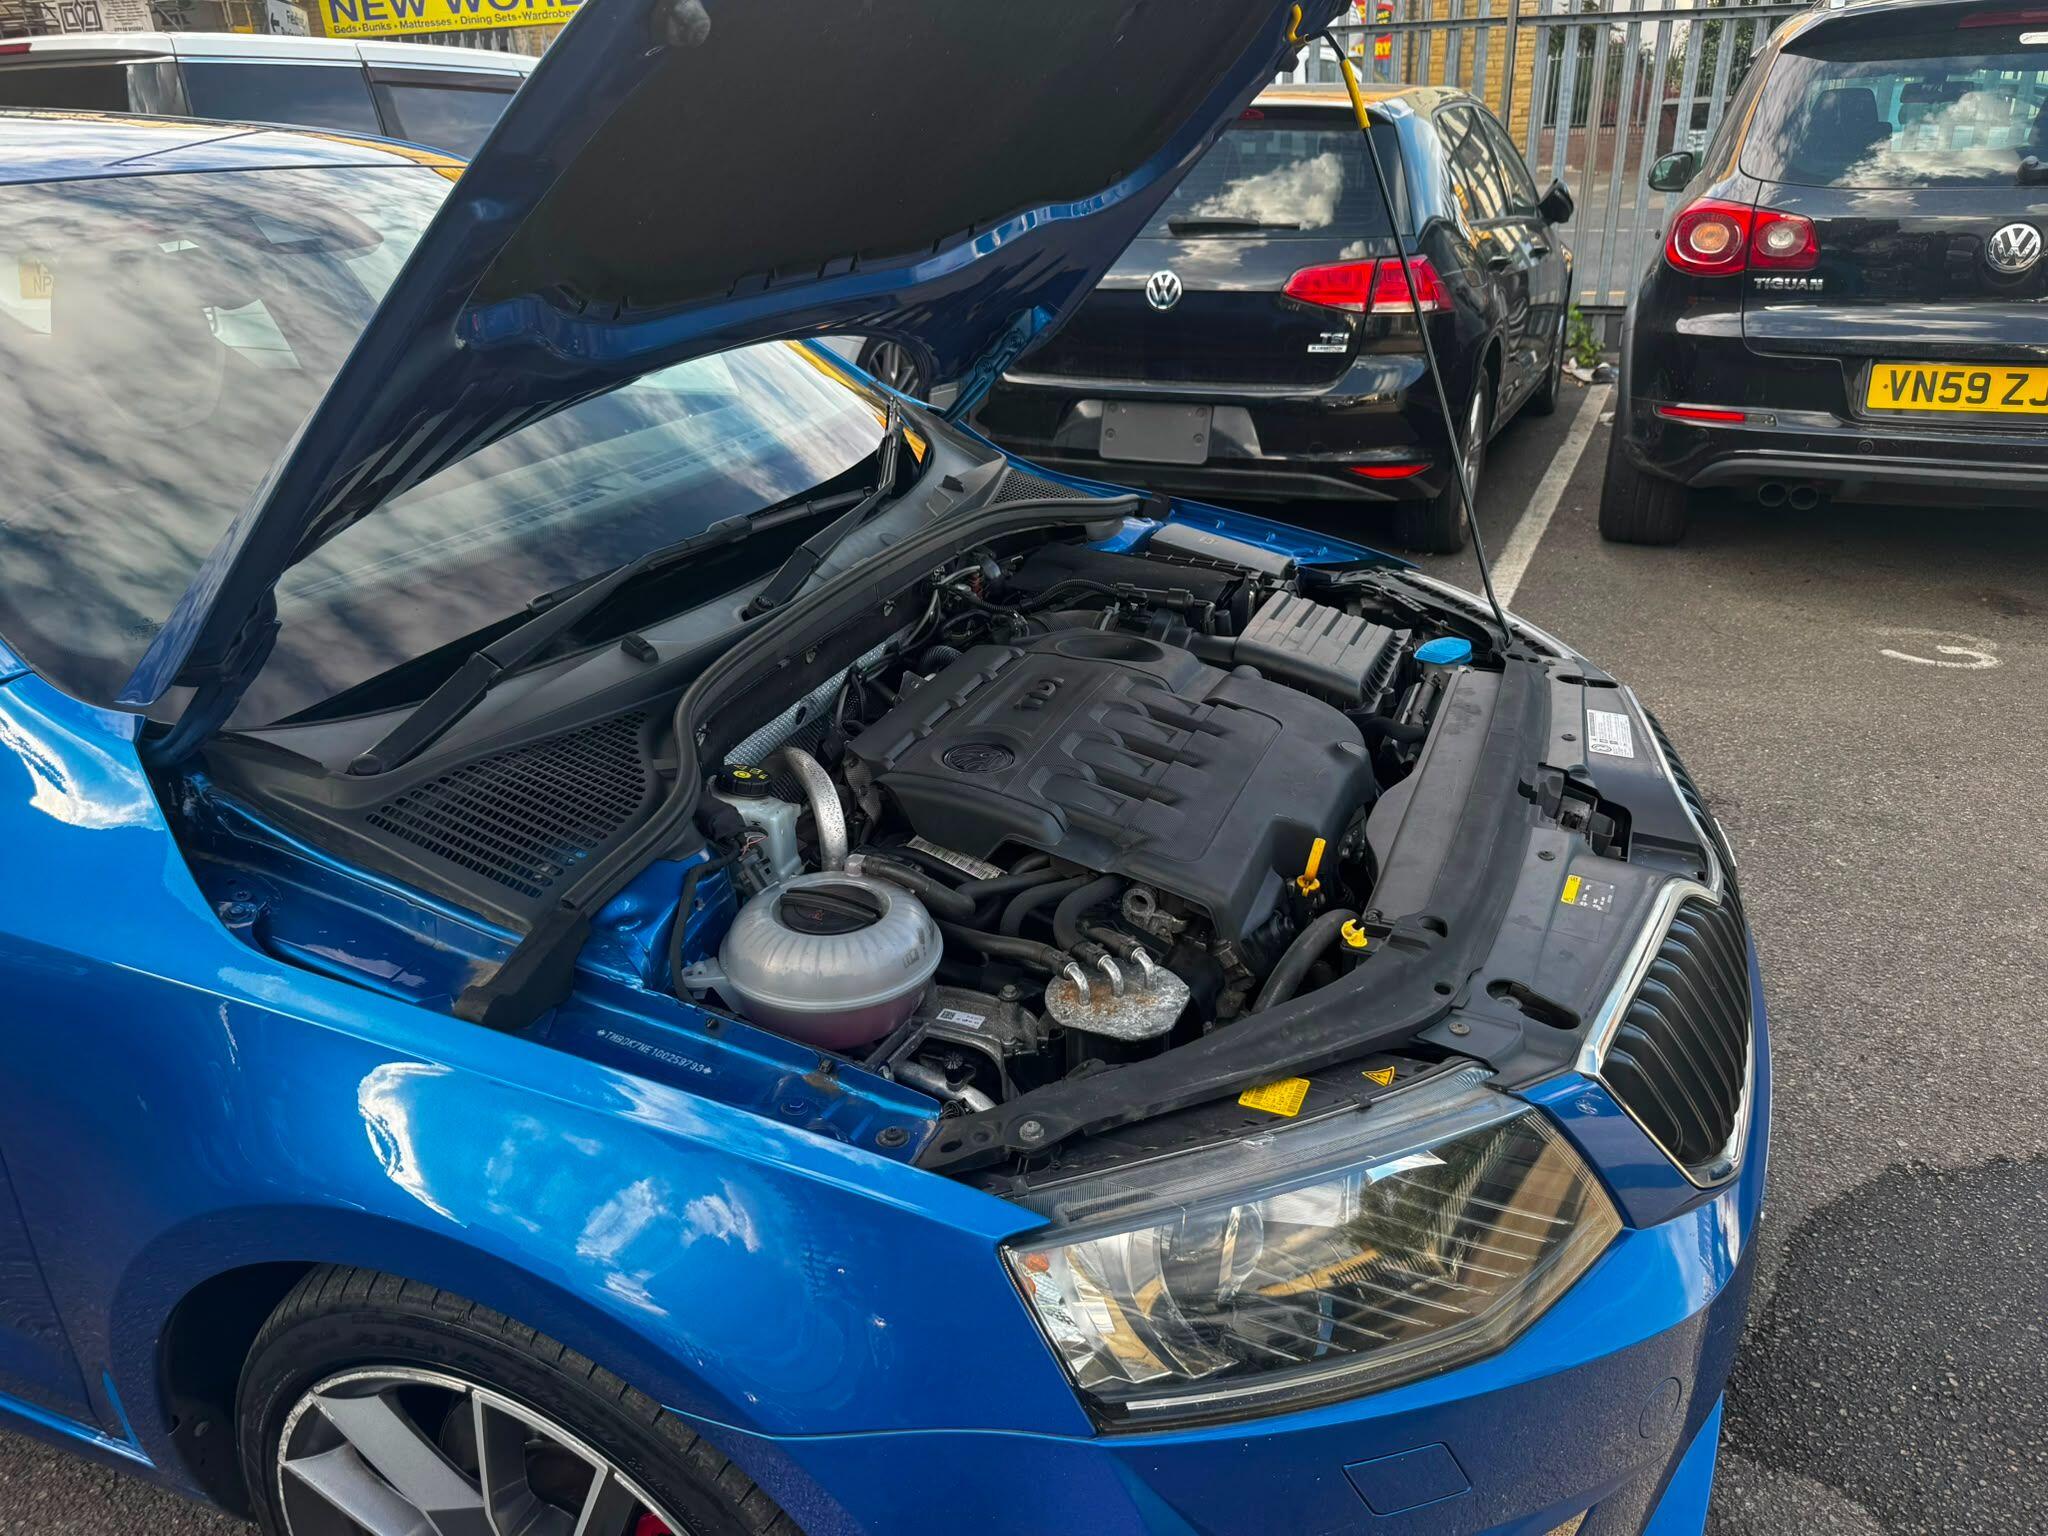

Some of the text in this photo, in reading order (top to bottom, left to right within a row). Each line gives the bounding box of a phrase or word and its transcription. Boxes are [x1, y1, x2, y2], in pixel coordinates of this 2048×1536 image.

[334, 23, 358, 34] Beds
[362, 21, 392, 32] Bunks
[400, 18, 452, 30] Mattresses
[460, 15, 493, 25] Dining
[495, 12, 517, 22] Sets
[1753, 277, 1825, 291] TIGUAN
[1889, 369, 1992, 405] VN59
